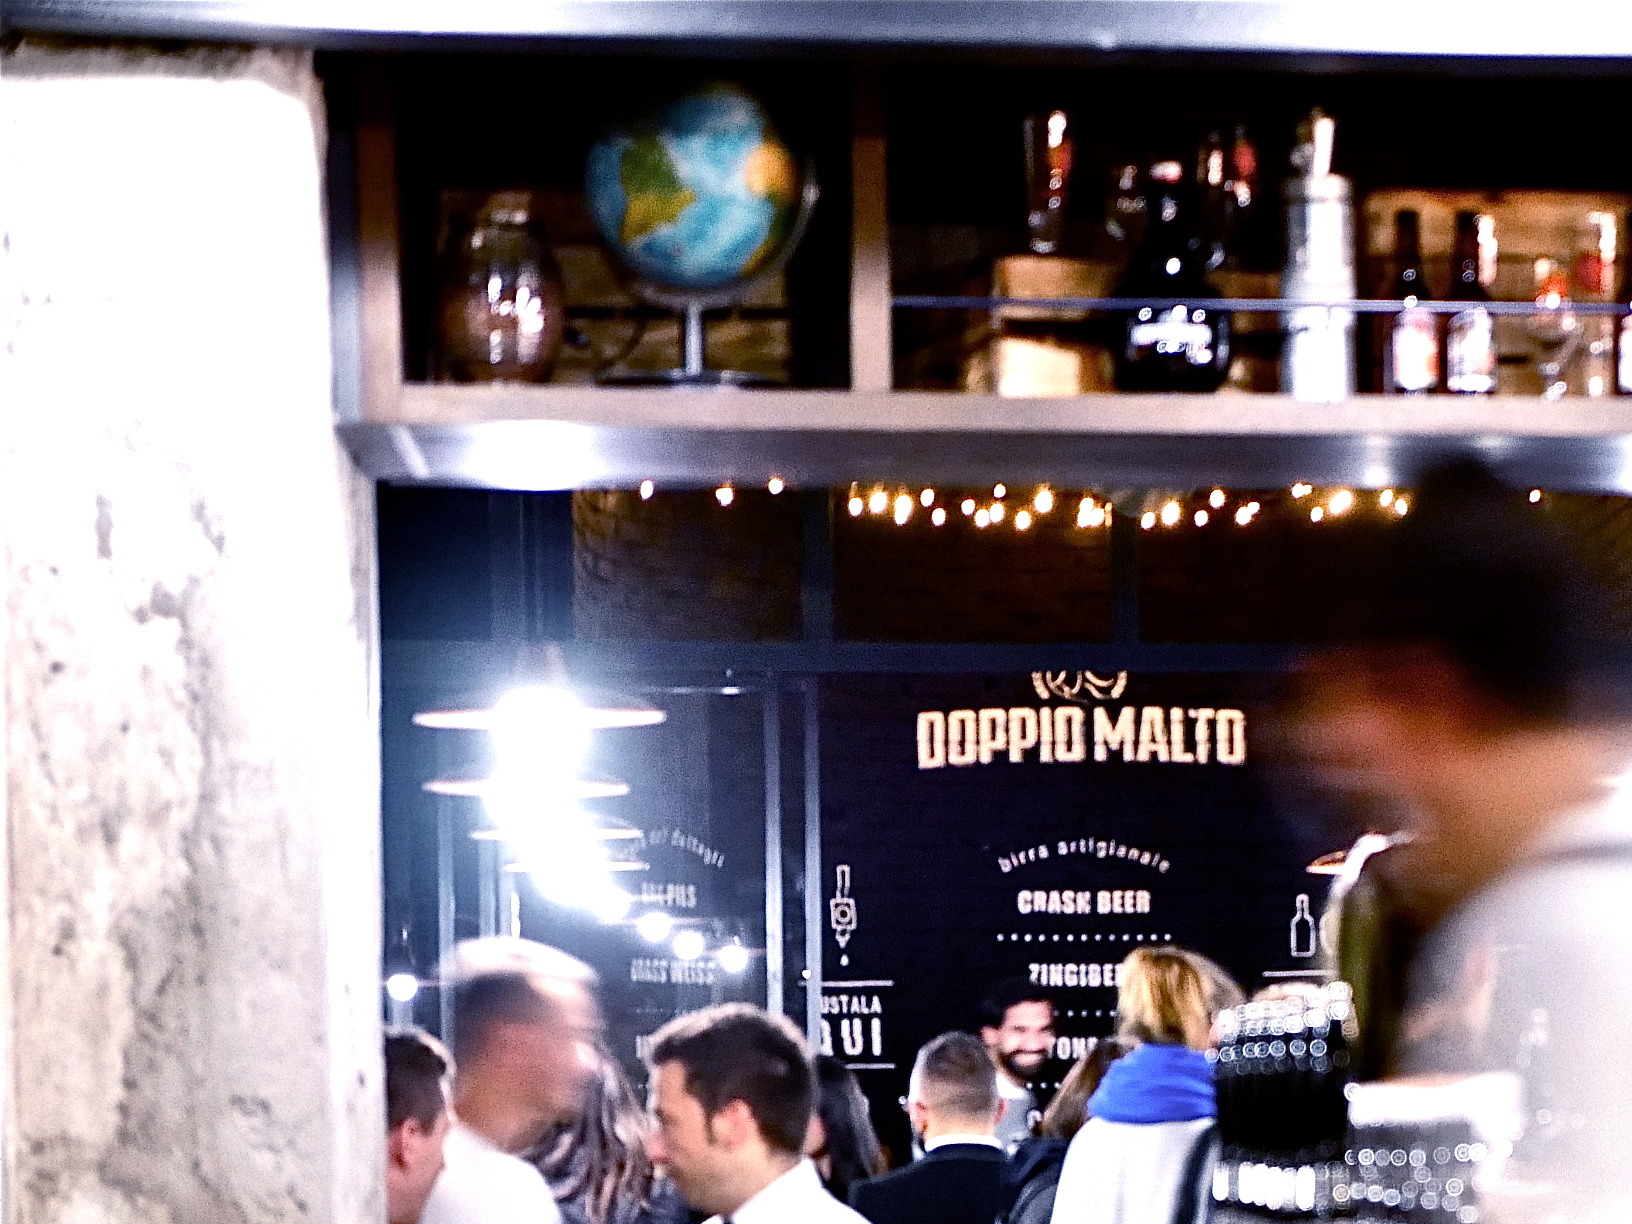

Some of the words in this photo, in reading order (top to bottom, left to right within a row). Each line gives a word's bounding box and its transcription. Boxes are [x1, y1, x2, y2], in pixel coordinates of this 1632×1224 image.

[917, 706, 1086, 769] DOPPIO
[1093, 706, 1247, 766] MALTO
[998, 844, 1050, 874] birra
[1057, 836, 1171, 874] artigianale
[1096, 889, 1152, 915] BEER
[820, 994, 883, 1015] USTALA
